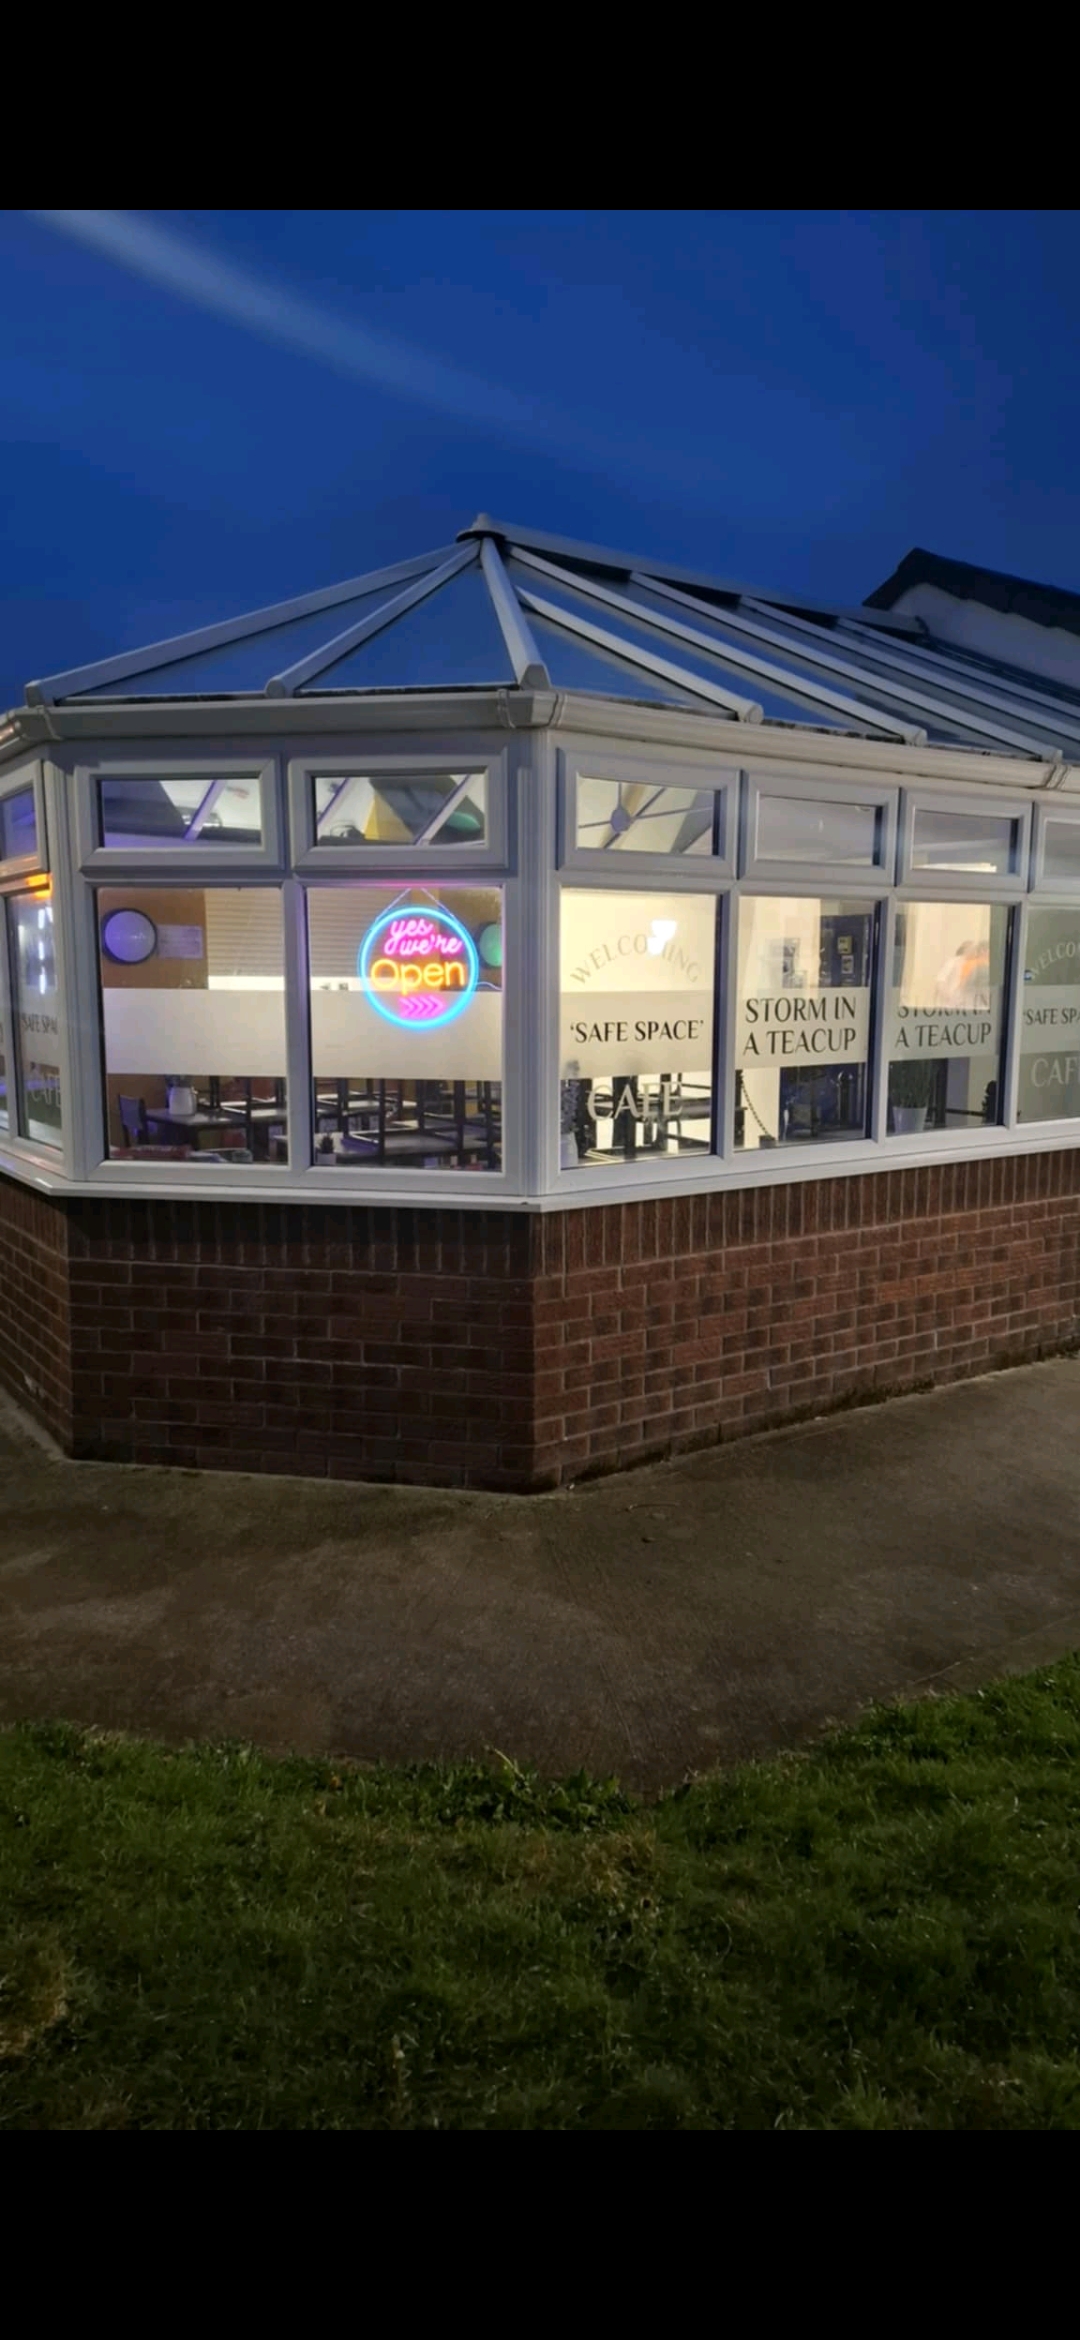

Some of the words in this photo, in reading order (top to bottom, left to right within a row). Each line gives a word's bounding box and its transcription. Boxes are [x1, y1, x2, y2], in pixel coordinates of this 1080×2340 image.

[384, 919, 434, 955] yes
[400, 935, 463, 956] we're
[1031, 941, 1080, 980] WELCO
[371, 959, 465, 996] Open
[745, 997, 827, 1023] STORM
[834, 996, 856, 1020] IN
[743, 1031, 760, 1056] A
[766, 1028, 856, 1054] TEACUP
[895, 1026, 910, 1048] A
[915, 1022, 992, 1047] TEACUP
[1031, 1056, 1080, 1088] CAF
[586, 1081, 683, 1121] CAFE
